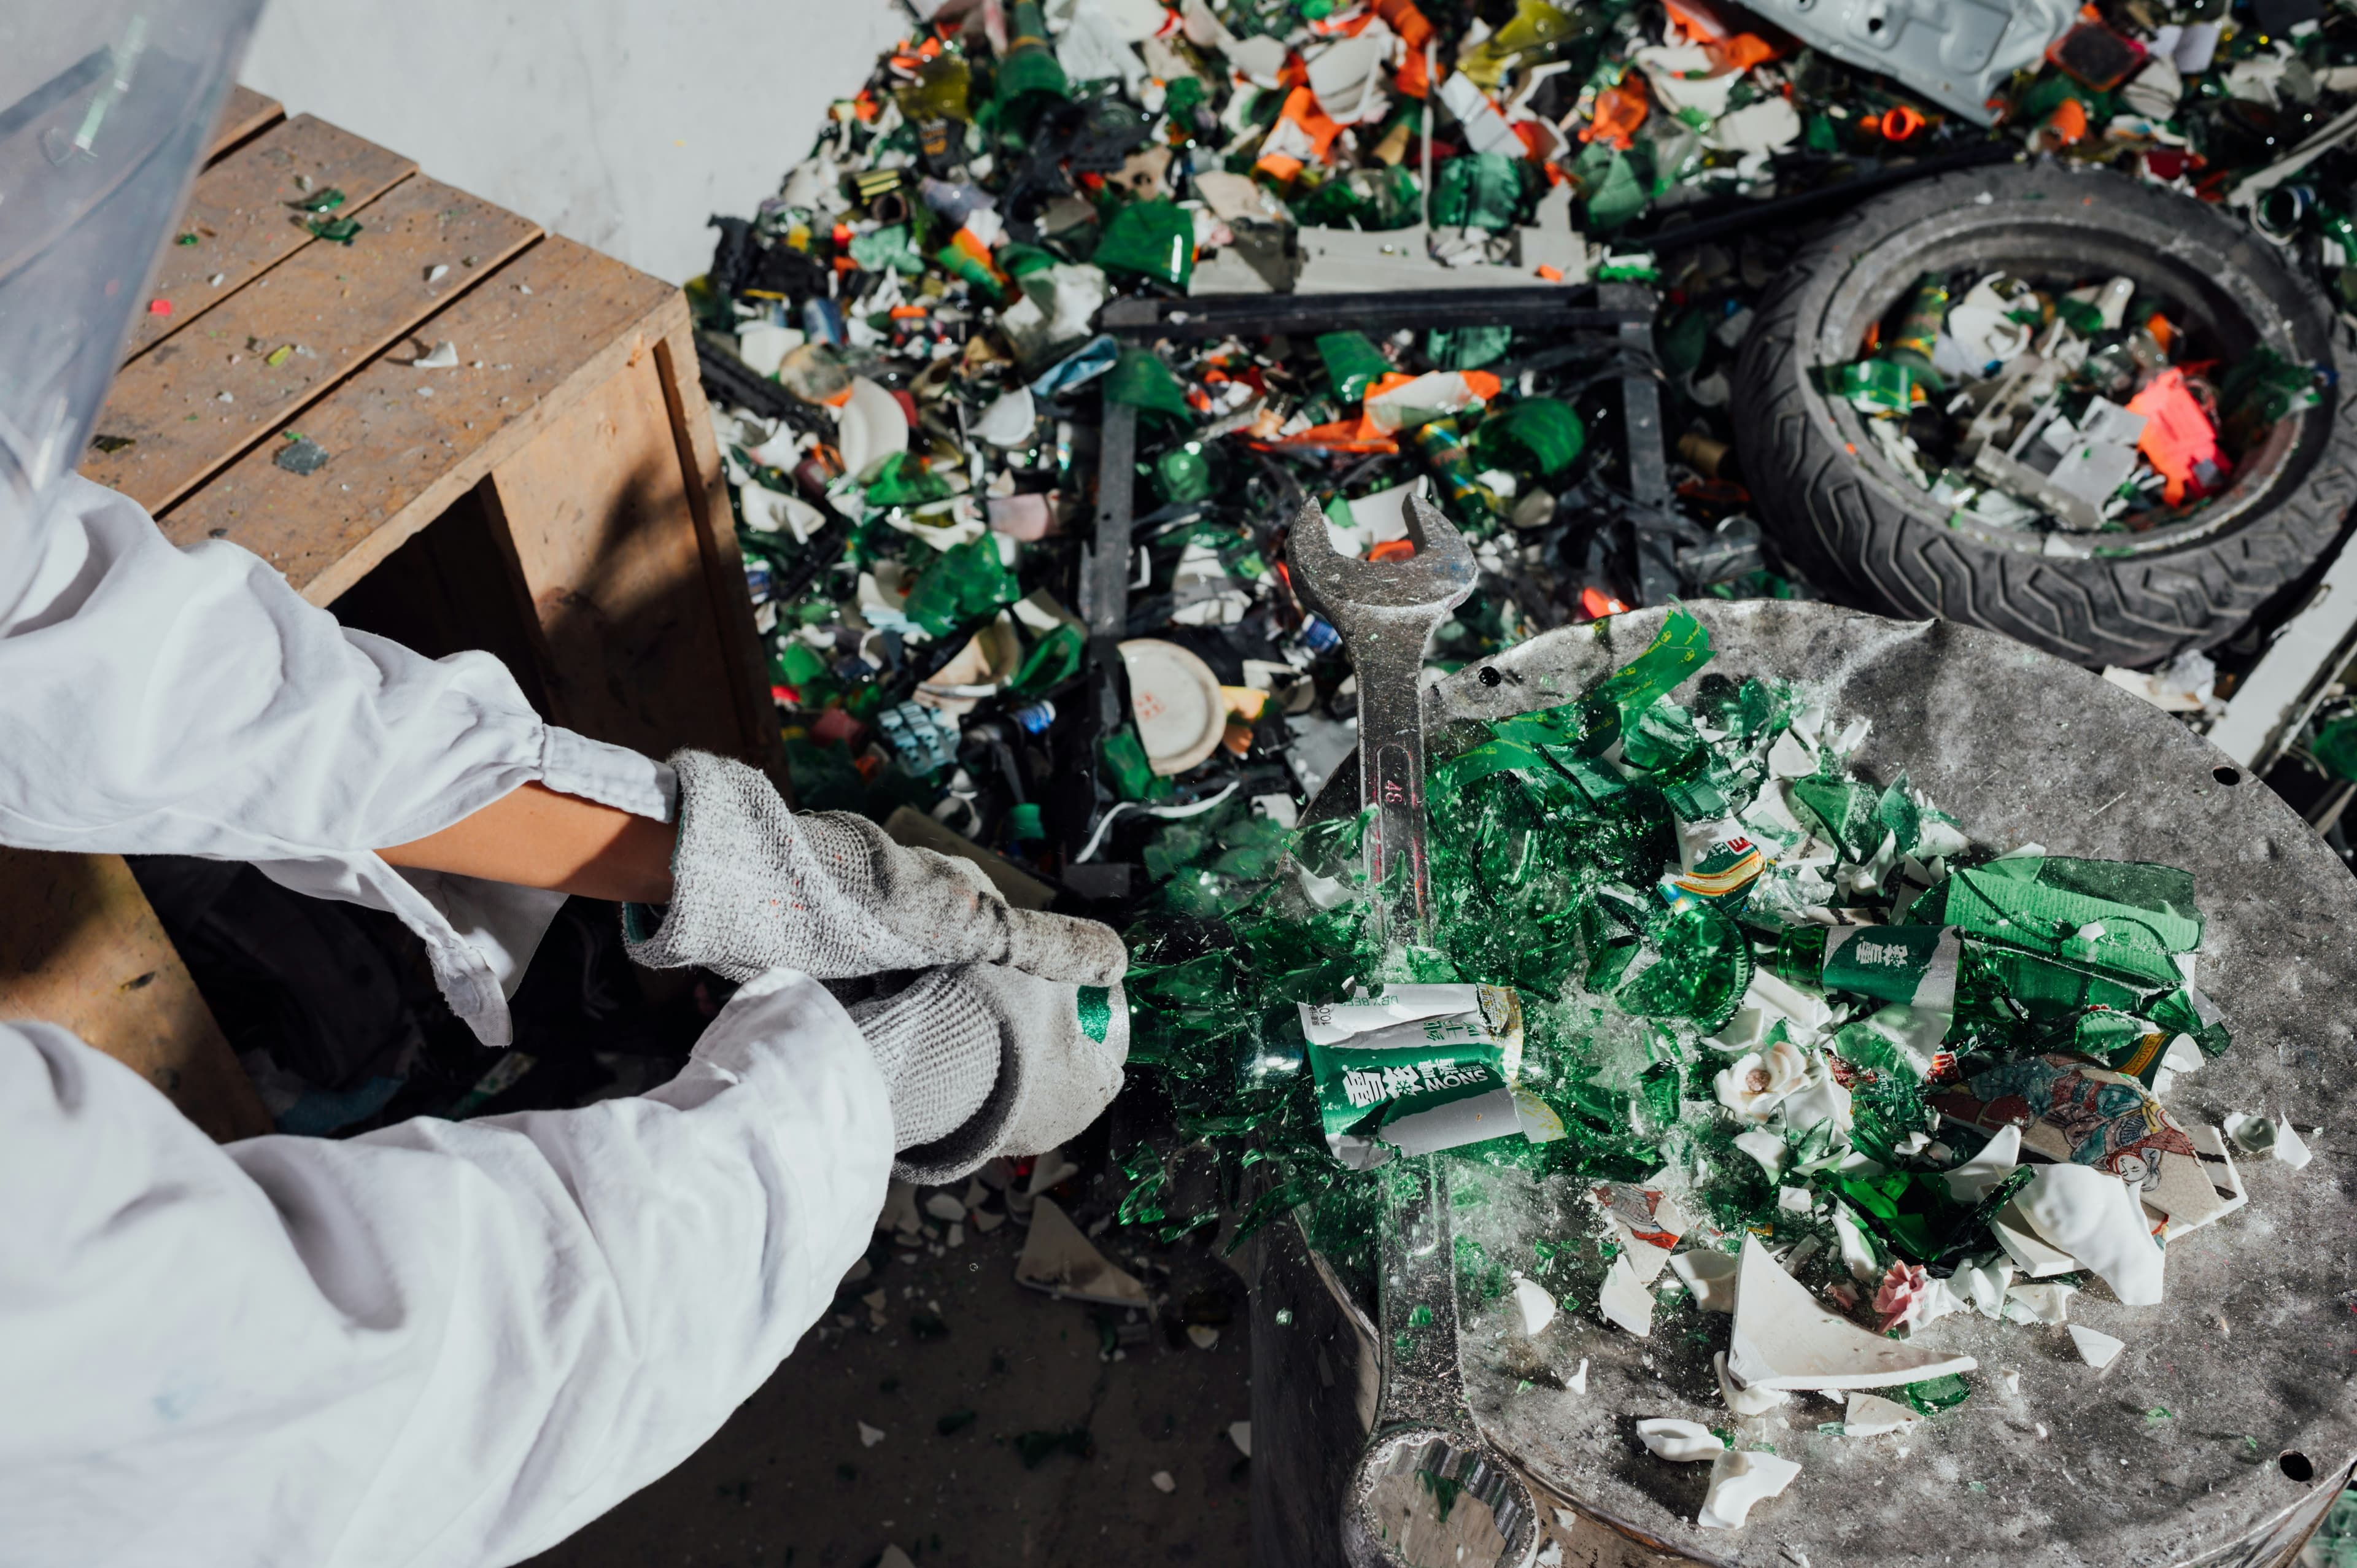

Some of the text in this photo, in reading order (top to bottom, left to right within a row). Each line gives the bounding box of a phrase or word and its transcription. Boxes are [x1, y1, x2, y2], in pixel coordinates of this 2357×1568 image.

[1385, 779, 1404, 803] 48
[1855, 940, 1908, 968] 雪花
[1341, 997, 1369, 1006] BEE
[1417, 1058, 1459, 1079] 啤酒
[1342, 1064, 1424, 1108] 雪花
[1425, 1070, 1488, 1092] SNOW
